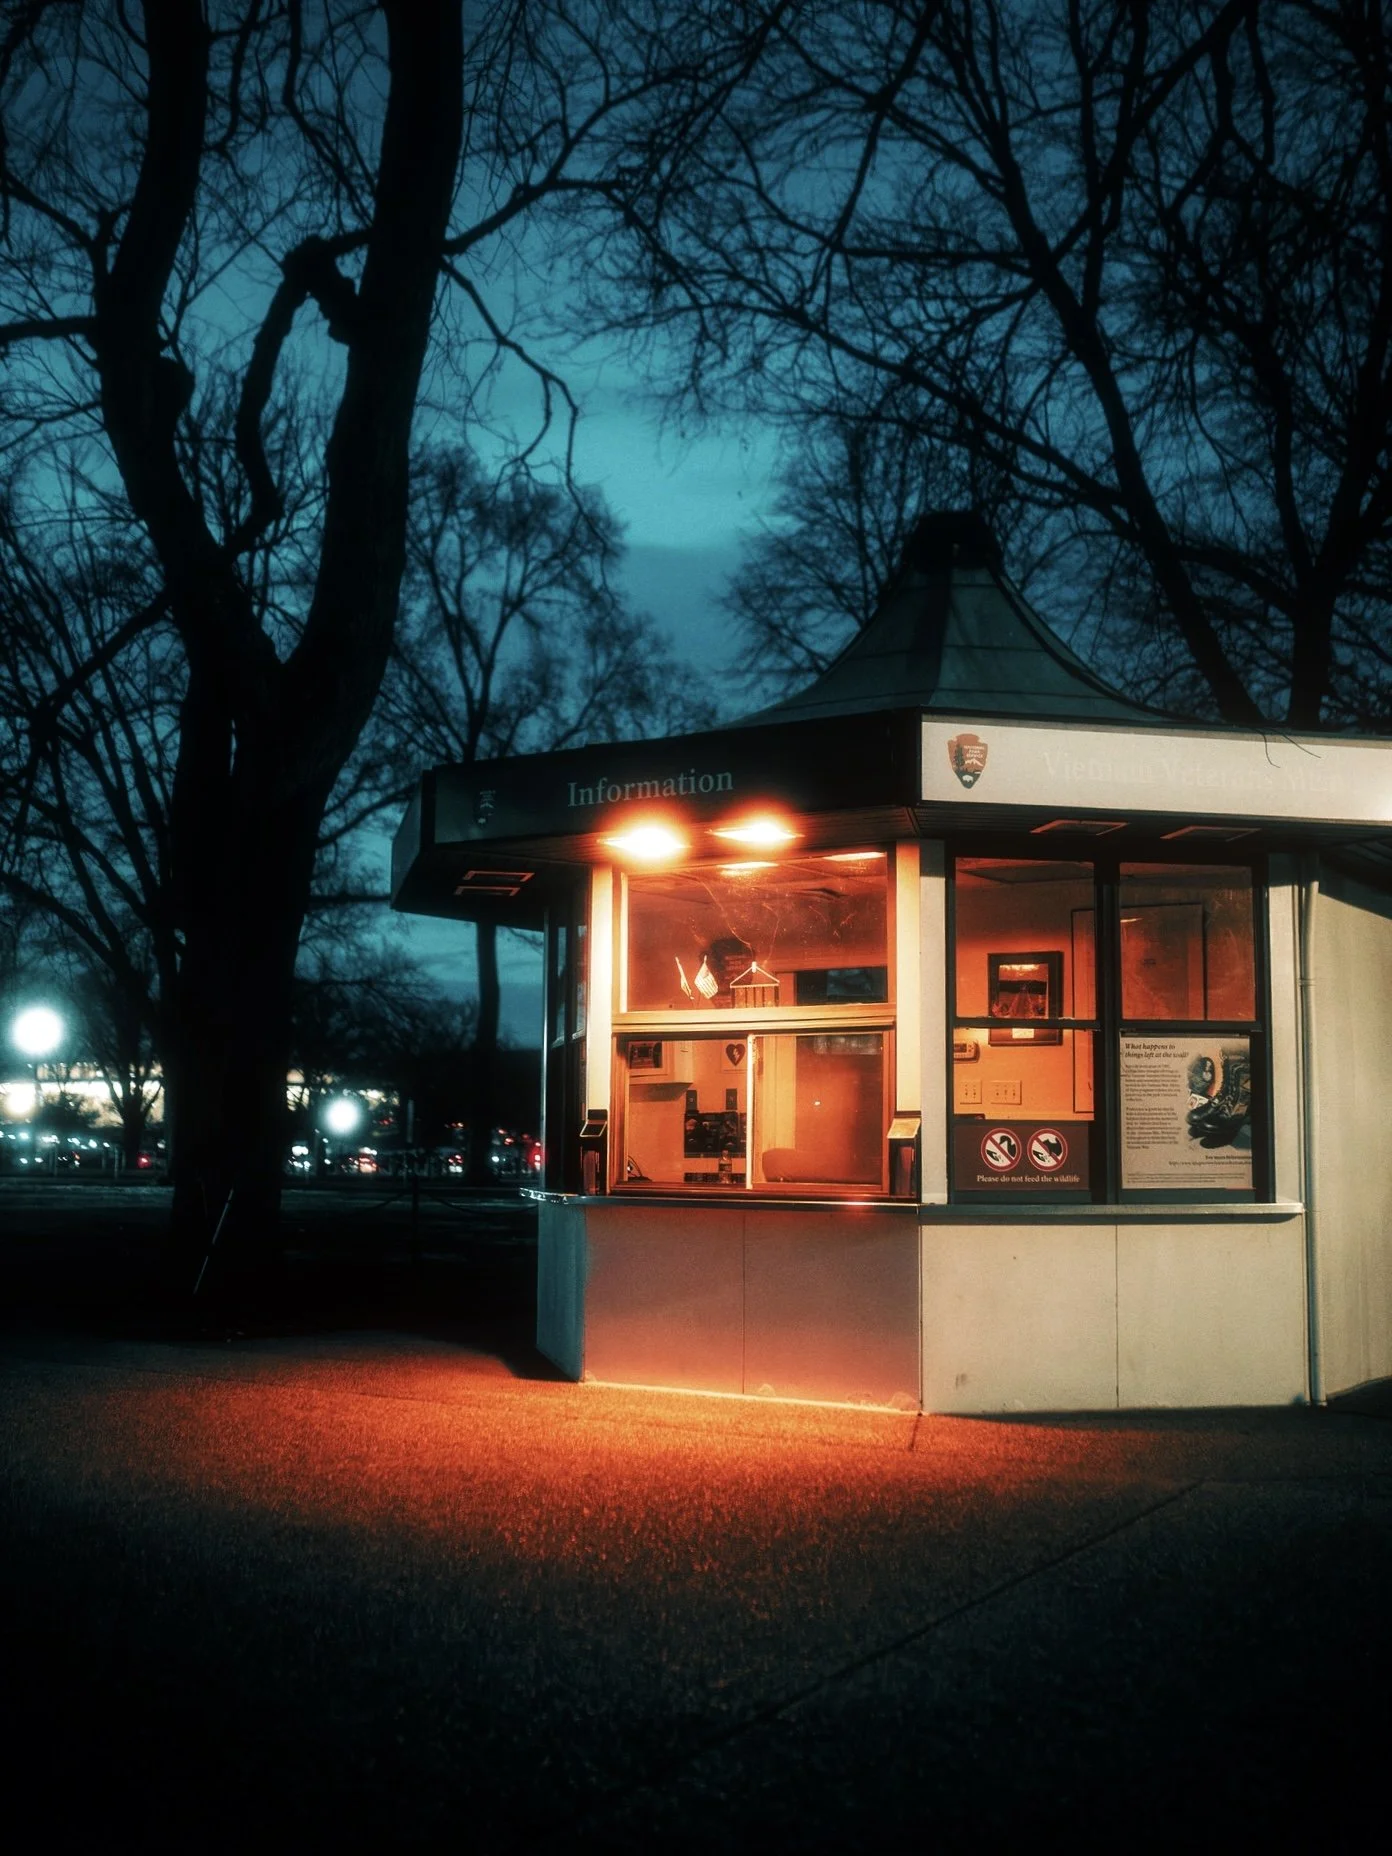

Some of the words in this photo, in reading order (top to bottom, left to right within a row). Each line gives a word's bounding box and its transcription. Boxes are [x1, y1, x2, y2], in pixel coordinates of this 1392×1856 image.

[567, 768, 734, 807] Information
[1142, 1043, 1168, 1051] happens
[977, 1175, 999, 1183] Please
[1000, 1175, 1010, 1183] do
[1011, 1175, 1023, 1183] not
[1024, 1175, 1040, 1183] feed
[1041, 1175, 1052, 1183] the
[1053, 1175, 1080, 1183] wildlife
